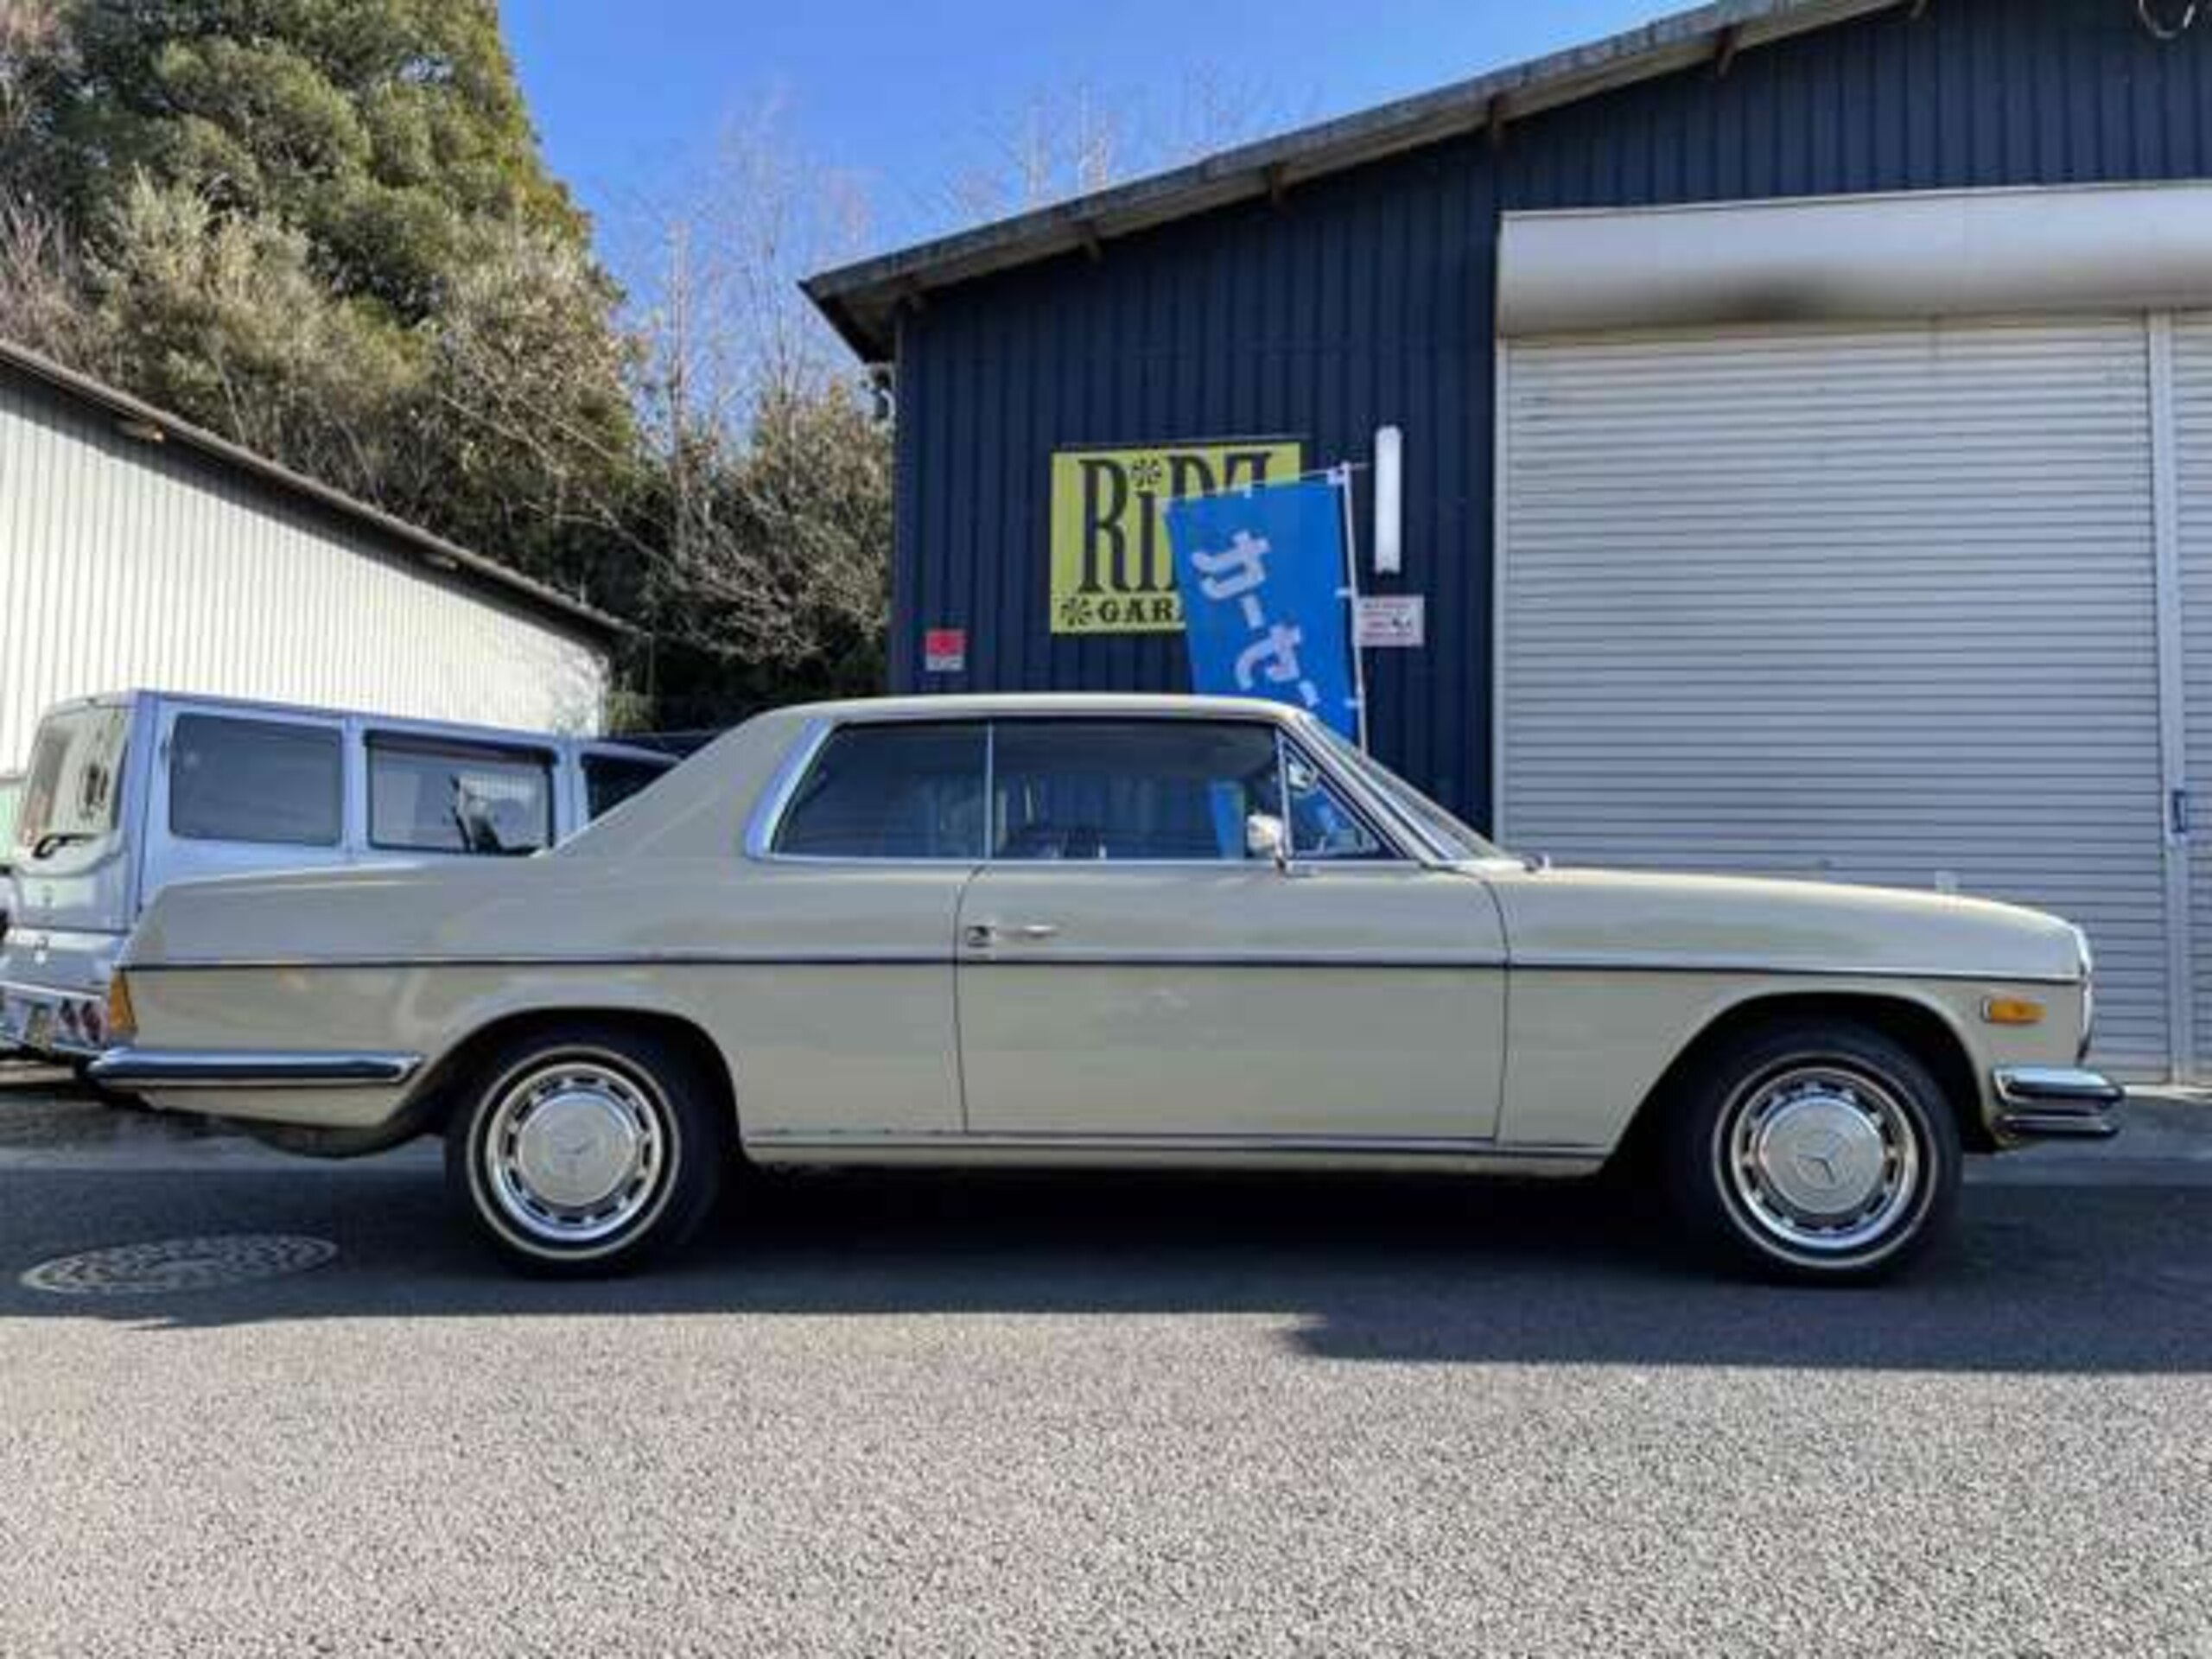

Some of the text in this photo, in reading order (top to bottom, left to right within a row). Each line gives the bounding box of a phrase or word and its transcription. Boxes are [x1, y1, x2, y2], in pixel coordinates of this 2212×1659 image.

[1097, 597, 1182, 623] GAR
[1191, 530, 1320, 708] カーセ
